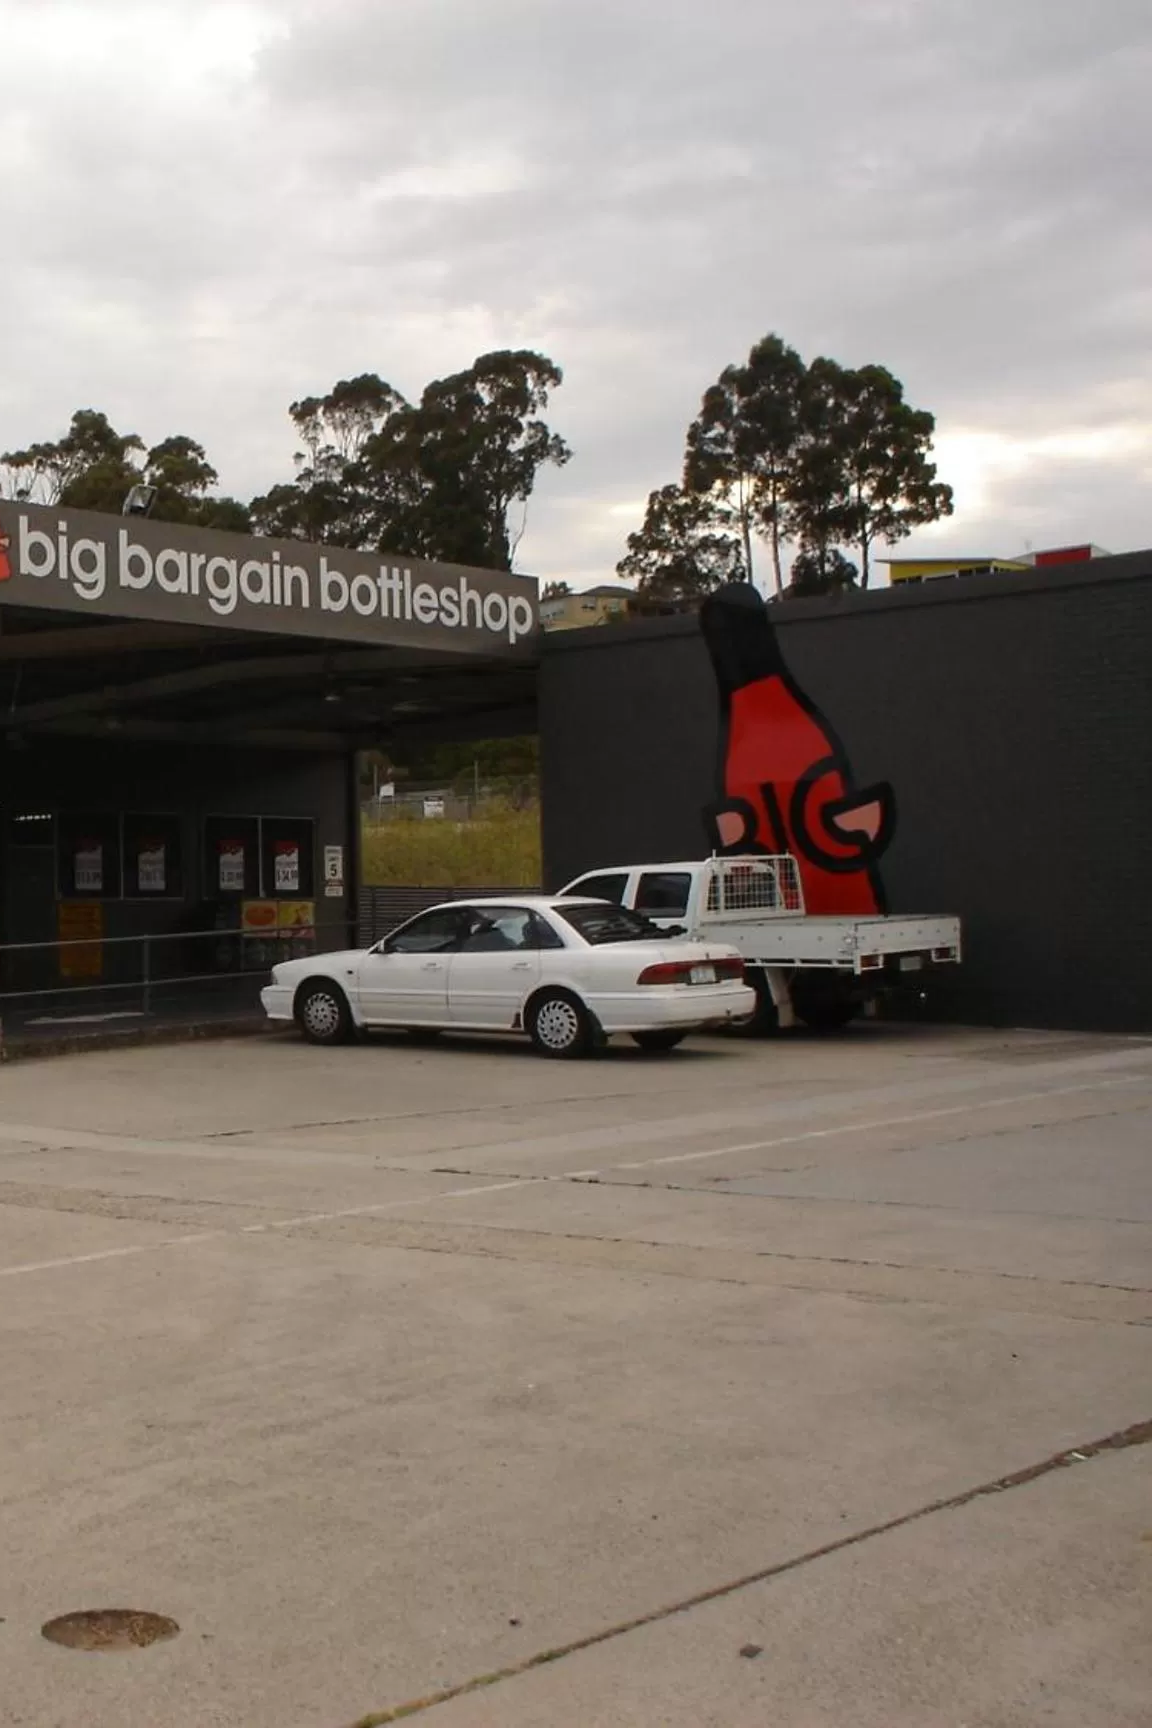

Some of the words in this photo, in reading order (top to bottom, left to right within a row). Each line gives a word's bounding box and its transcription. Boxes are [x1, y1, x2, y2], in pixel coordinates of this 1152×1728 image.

[18, 514, 106, 600] big
[118, 529, 309, 615] bargain
[320, 556, 533, 644] bottleshop
[330, 863, 337, 877] 5
